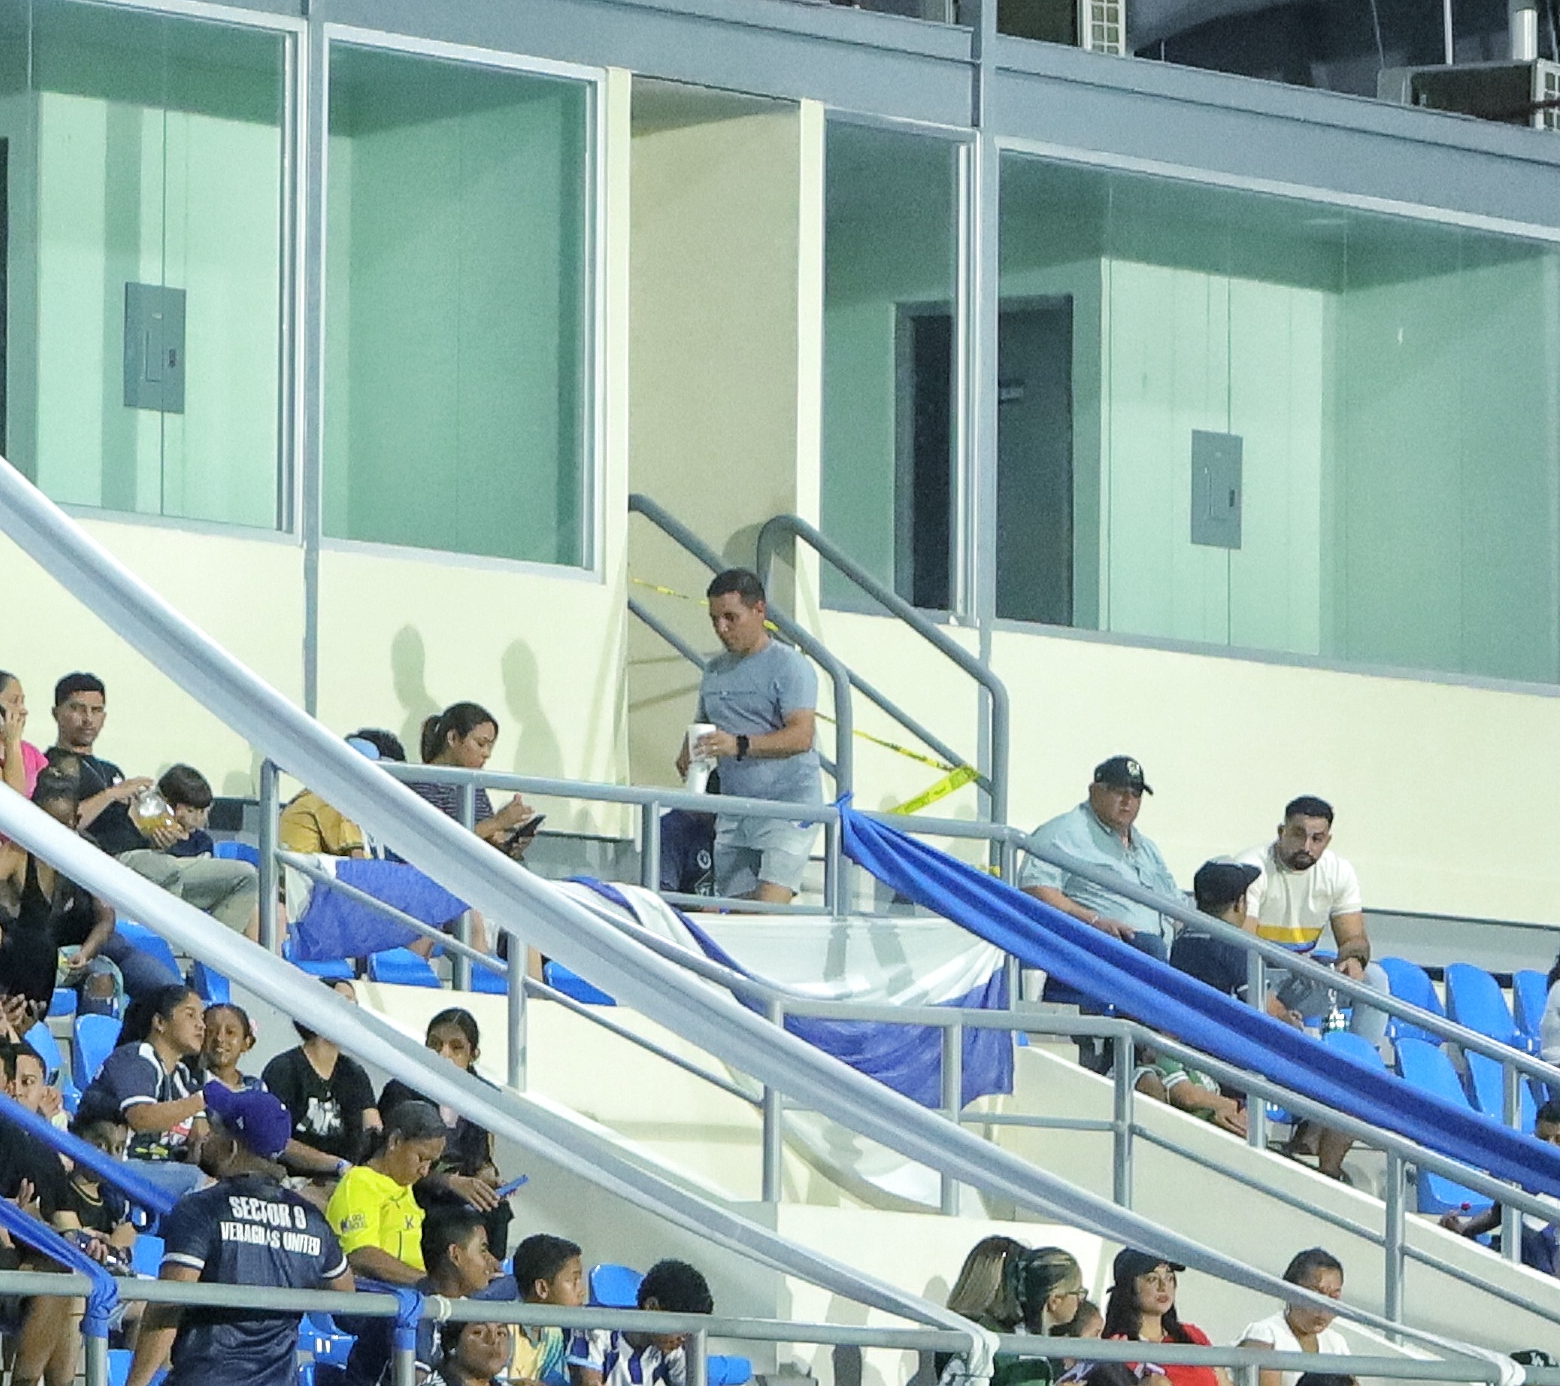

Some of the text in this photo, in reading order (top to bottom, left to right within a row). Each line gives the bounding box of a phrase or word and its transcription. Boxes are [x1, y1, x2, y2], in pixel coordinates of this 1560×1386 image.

[228, 1196, 308, 1231] SECTOR 9
[282, 1231, 322, 1256] UNITED
